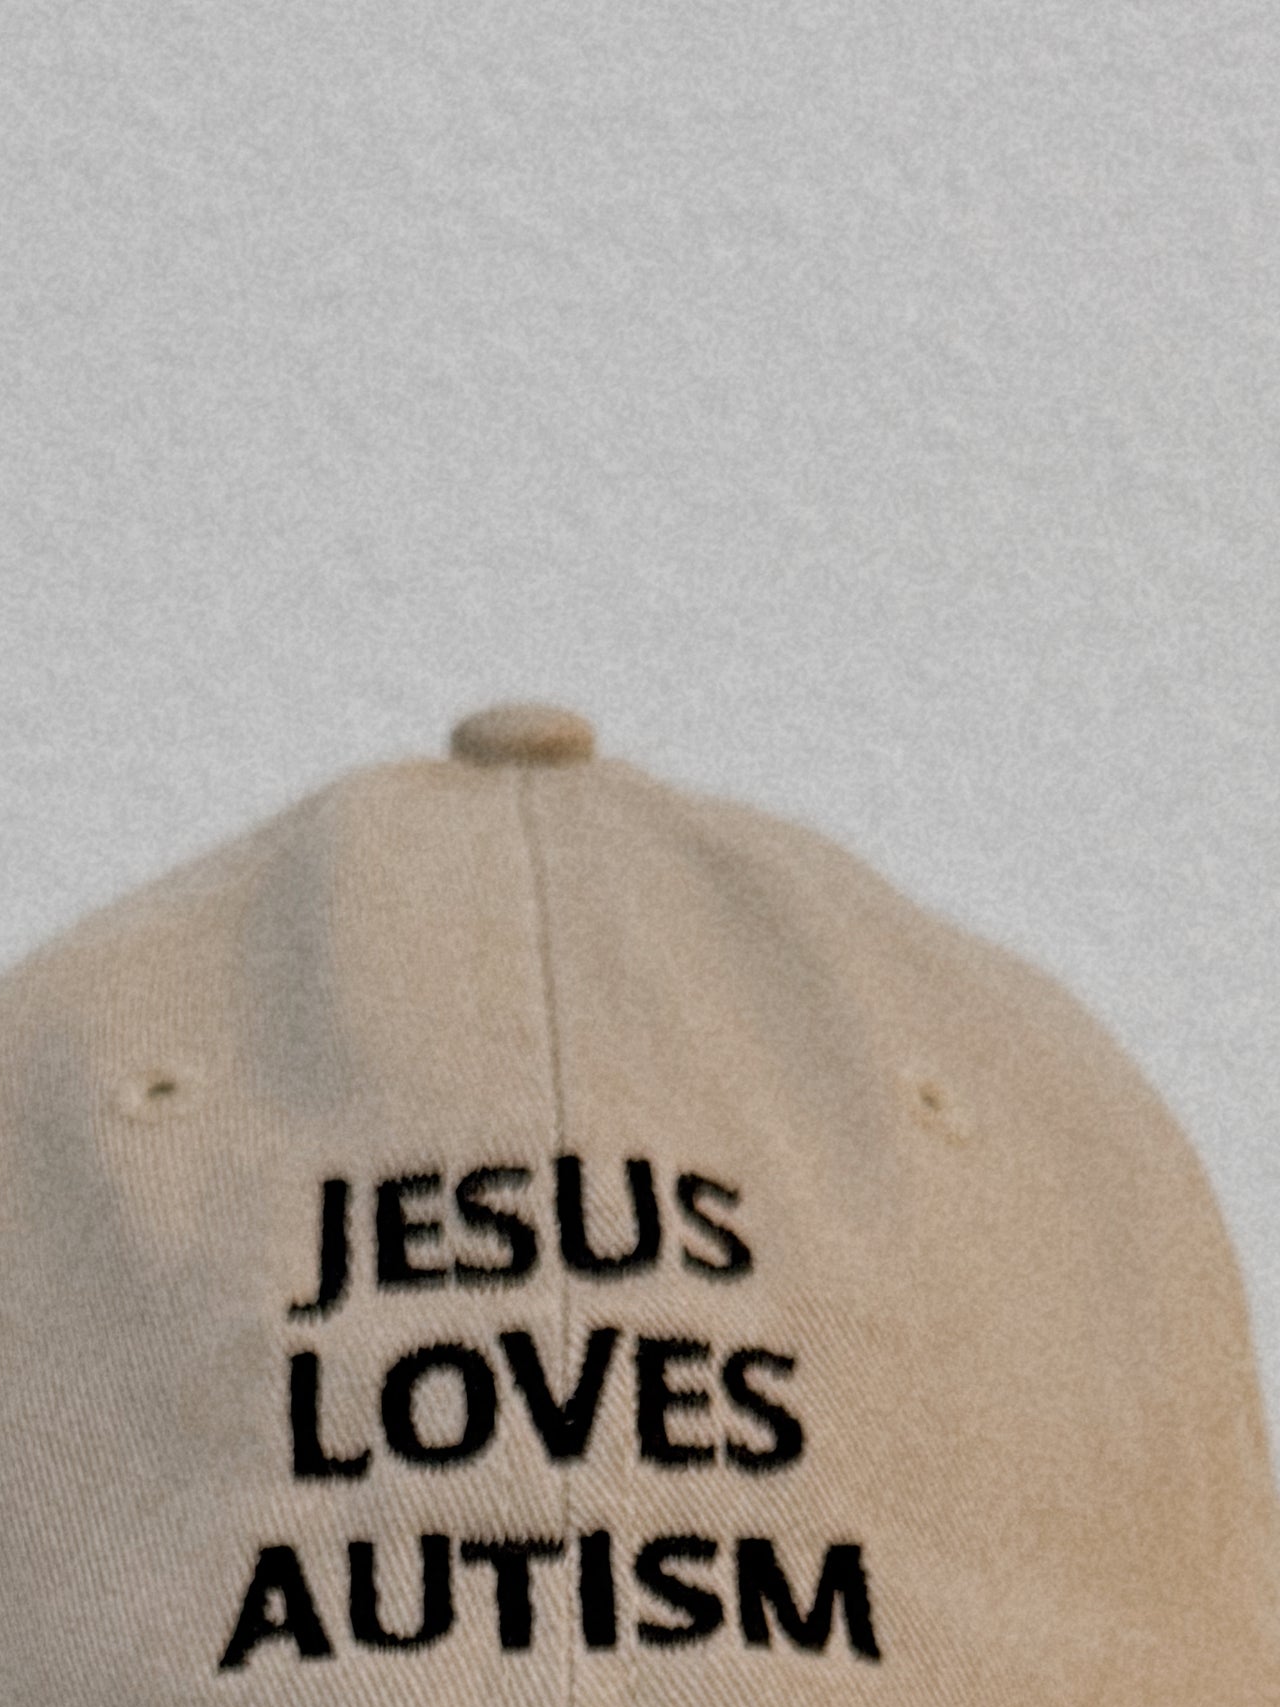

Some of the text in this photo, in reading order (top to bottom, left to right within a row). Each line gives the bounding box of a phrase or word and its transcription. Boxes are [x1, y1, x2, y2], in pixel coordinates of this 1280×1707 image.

[287, 1150, 755, 1320] JESUS
[287, 1325, 807, 1484] LOVES
[216, 1527, 883, 1673] AUTISM
